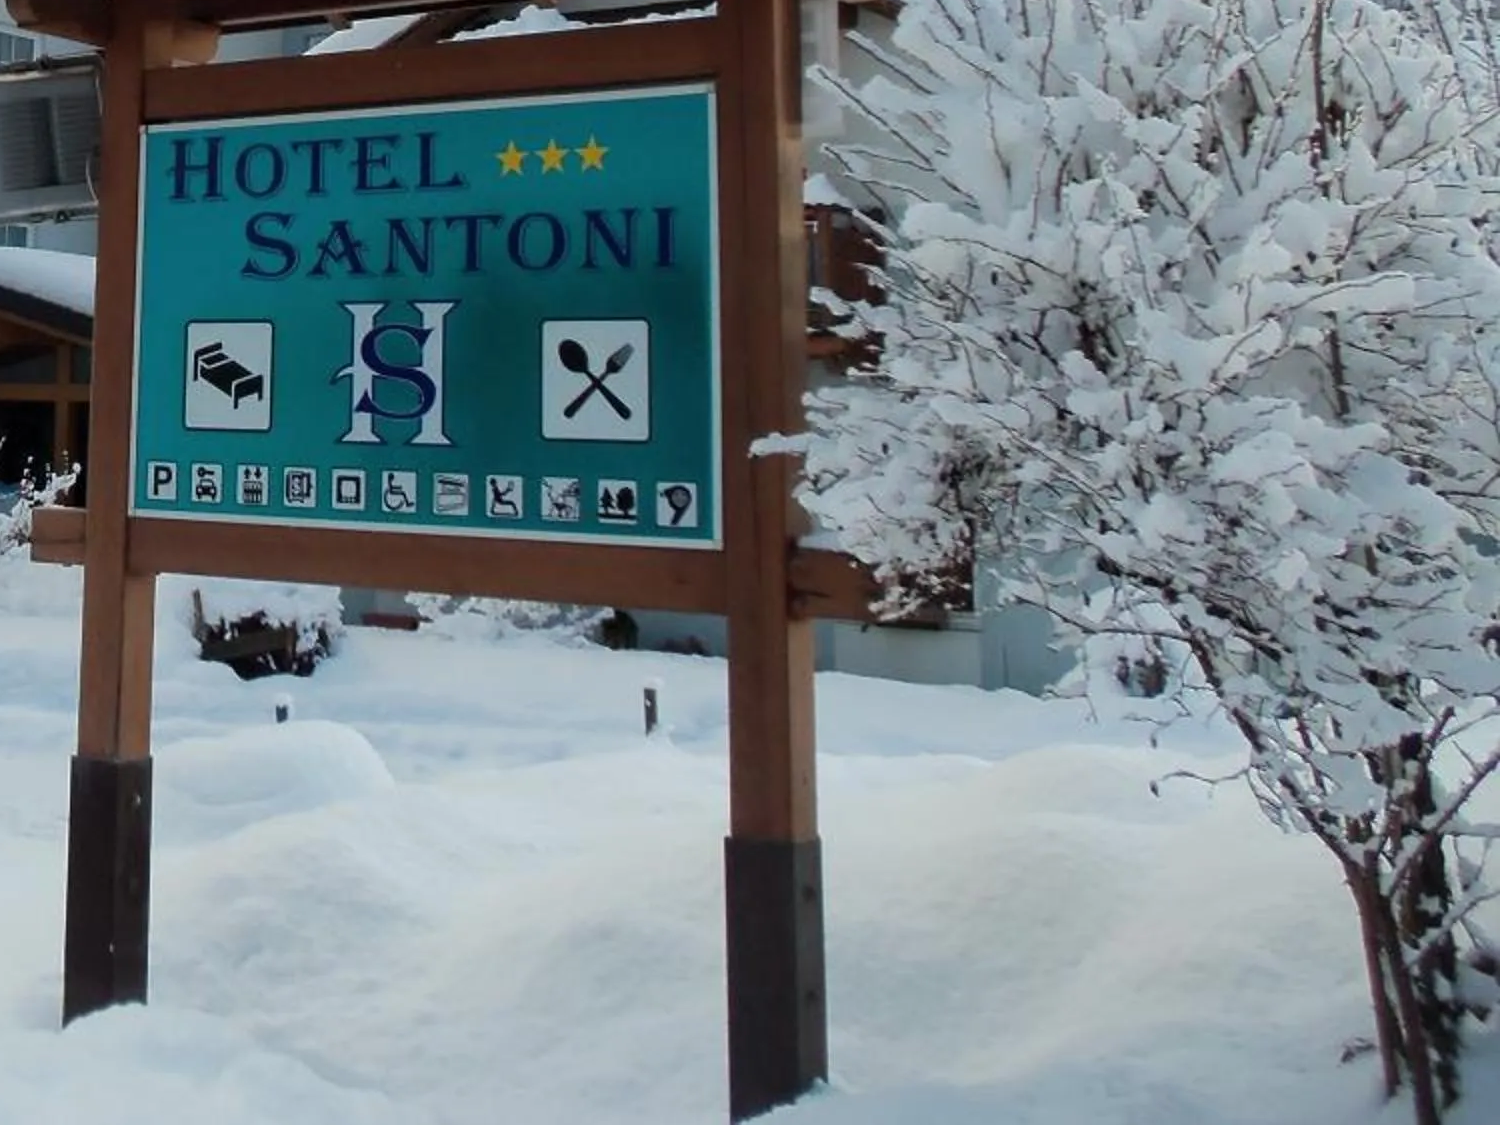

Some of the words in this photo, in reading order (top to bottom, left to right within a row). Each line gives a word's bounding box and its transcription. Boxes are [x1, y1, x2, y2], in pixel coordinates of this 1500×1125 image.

[169, 131, 470, 202] HOTEL
[241, 206, 678, 280] SANTONI
[153, 465, 173, 496] P
